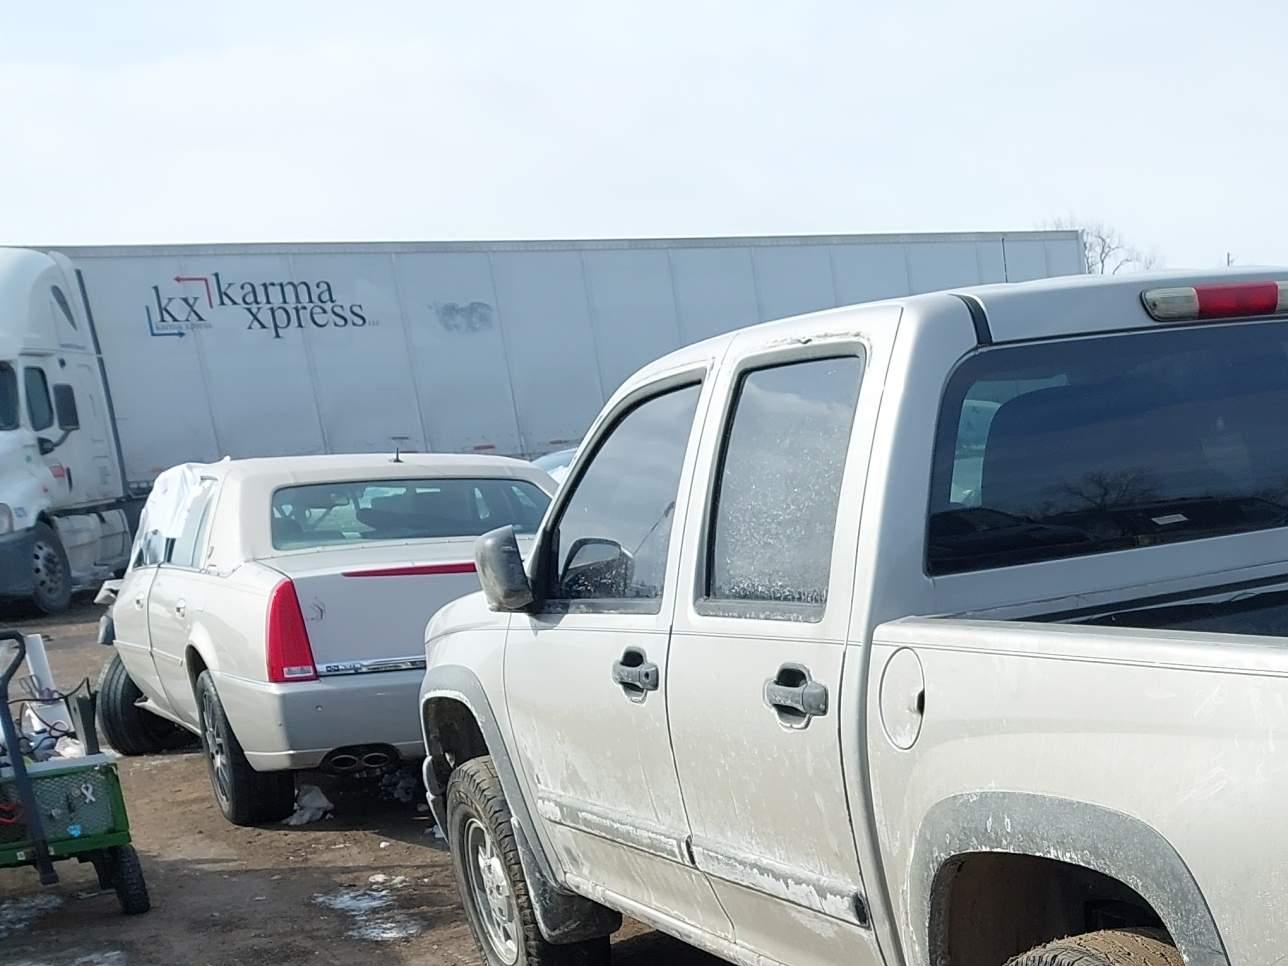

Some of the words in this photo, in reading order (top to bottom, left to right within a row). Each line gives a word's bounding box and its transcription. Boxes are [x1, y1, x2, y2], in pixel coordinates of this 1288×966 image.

[152, 285, 206, 323] kx
[211, 272, 337, 306] karma
[246, 302, 368, 339] xpress
